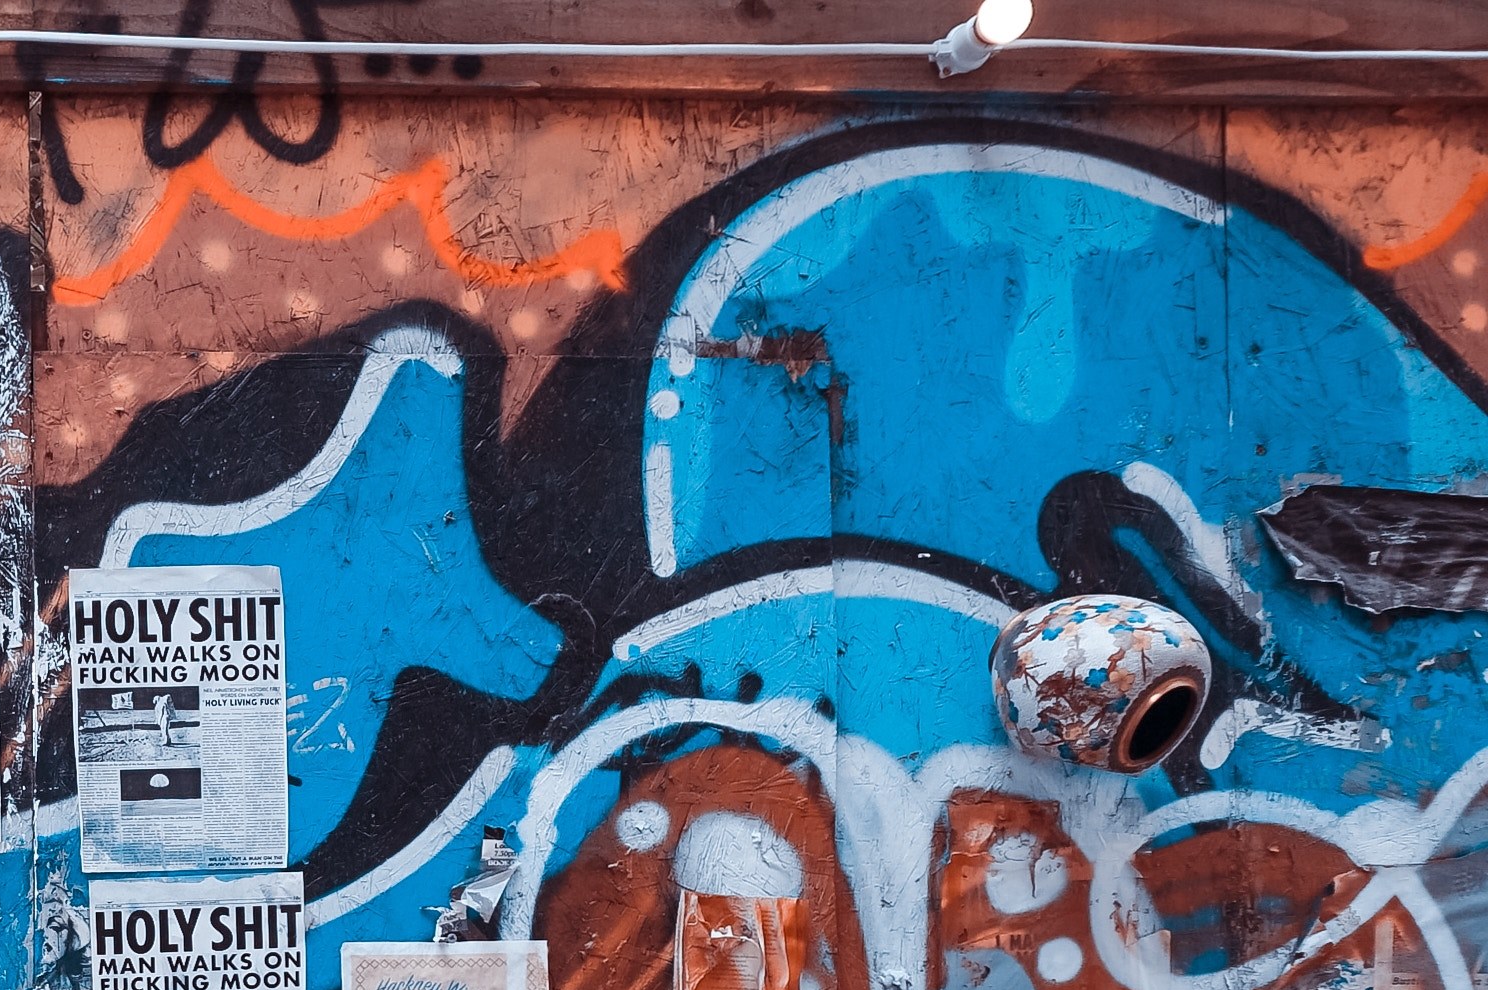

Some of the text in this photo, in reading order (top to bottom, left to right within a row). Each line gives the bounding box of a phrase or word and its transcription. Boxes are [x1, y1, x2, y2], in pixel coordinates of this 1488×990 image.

[74, 597, 281, 645] HOLY SHIT
[77, 643, 280, 665] MAN WALKS ON
[79, 664, 279, 685] FUCKING MOON
[229, 698, 257, 706] LIVING
[95, 904, 302, 956] HOLY SHIT
[98, 951, 301, 976] MAN WALKS ON
[221, 971, 300, 990] MOON
